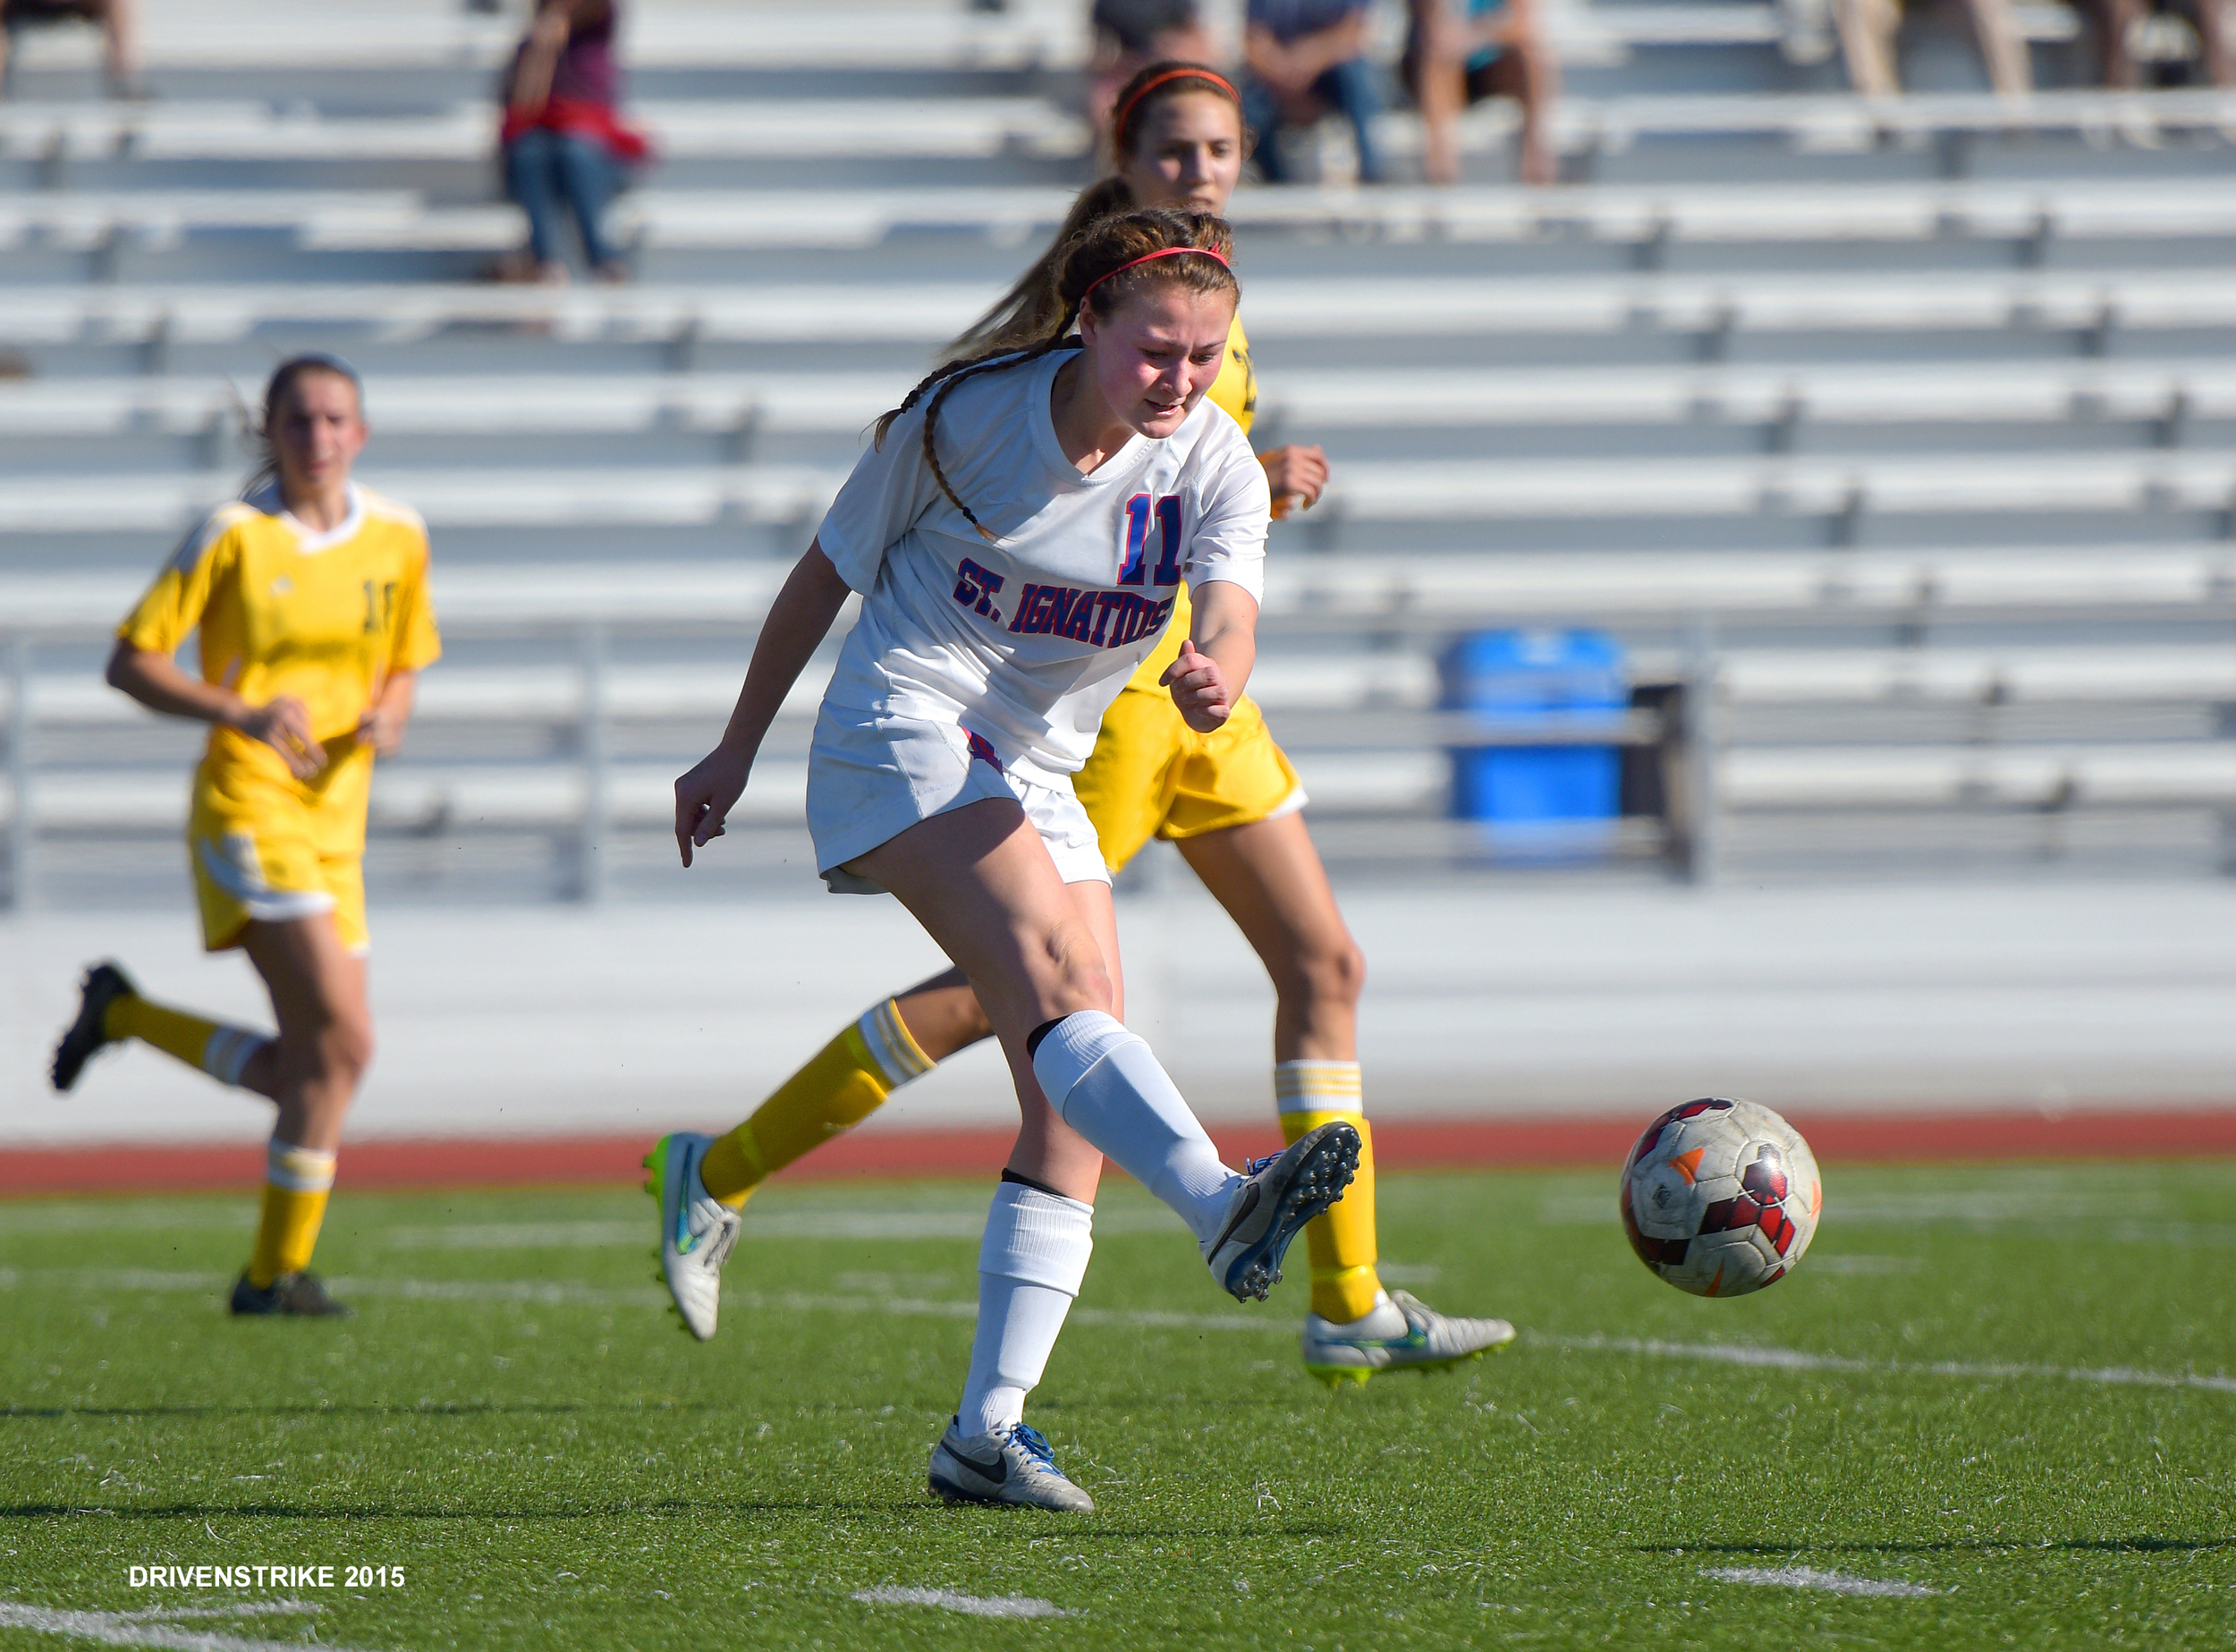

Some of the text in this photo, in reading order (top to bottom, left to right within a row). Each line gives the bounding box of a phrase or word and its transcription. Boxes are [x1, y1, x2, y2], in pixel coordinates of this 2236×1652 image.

[1117, 493, 1182, 586] 11
[953, 557, 1174, 648] ST. IGNATIUS
